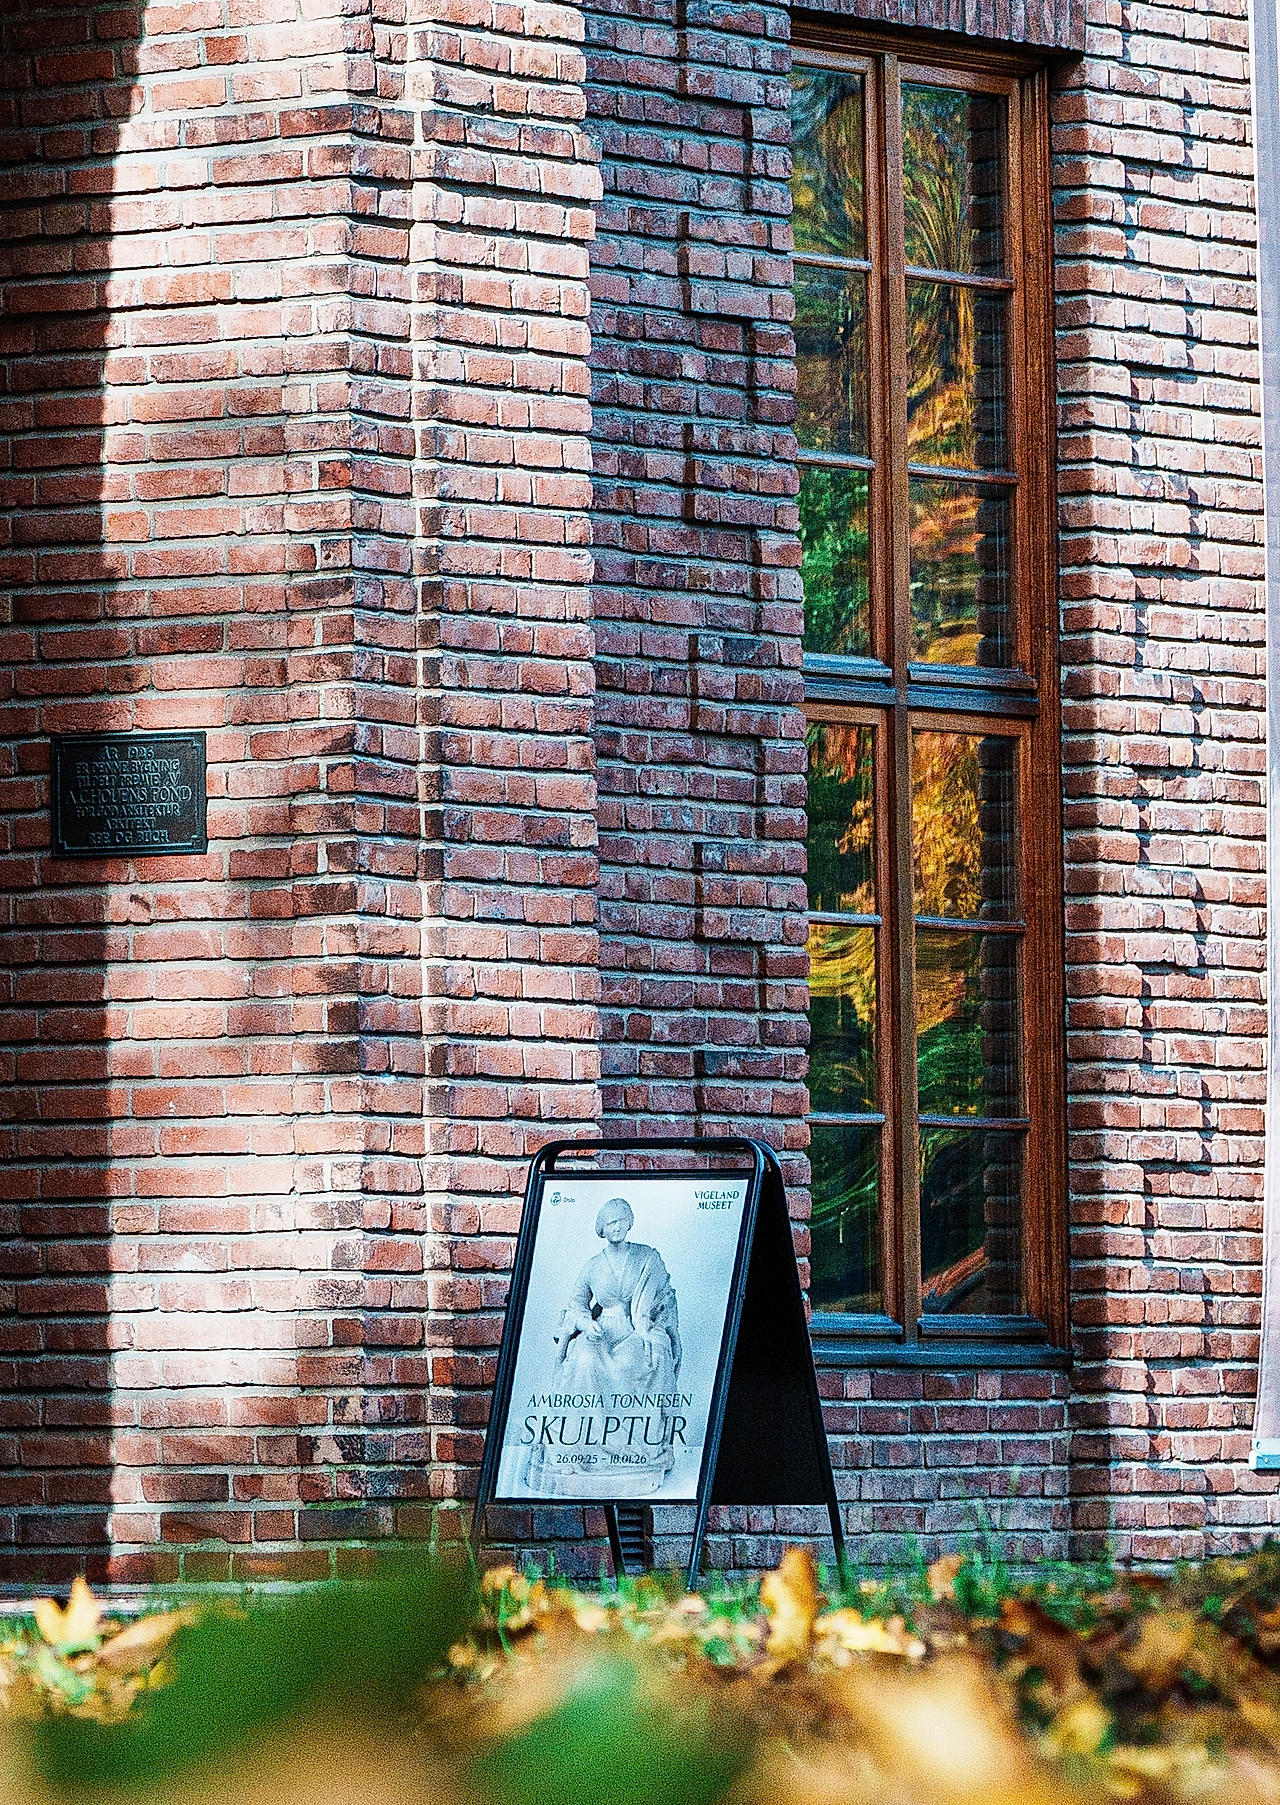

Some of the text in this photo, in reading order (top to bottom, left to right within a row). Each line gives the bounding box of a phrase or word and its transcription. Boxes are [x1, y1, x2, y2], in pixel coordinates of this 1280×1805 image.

[694, 1190, 740, 1199] VIGELAND
[696, 1200, 734, 1210] MUSEET
[527, 1393, 605, 1408] AMBROSIA
[520, 1415, 687, 1446] SKULPTUR
[556, 1453, 598, 1464] 26.09.25
